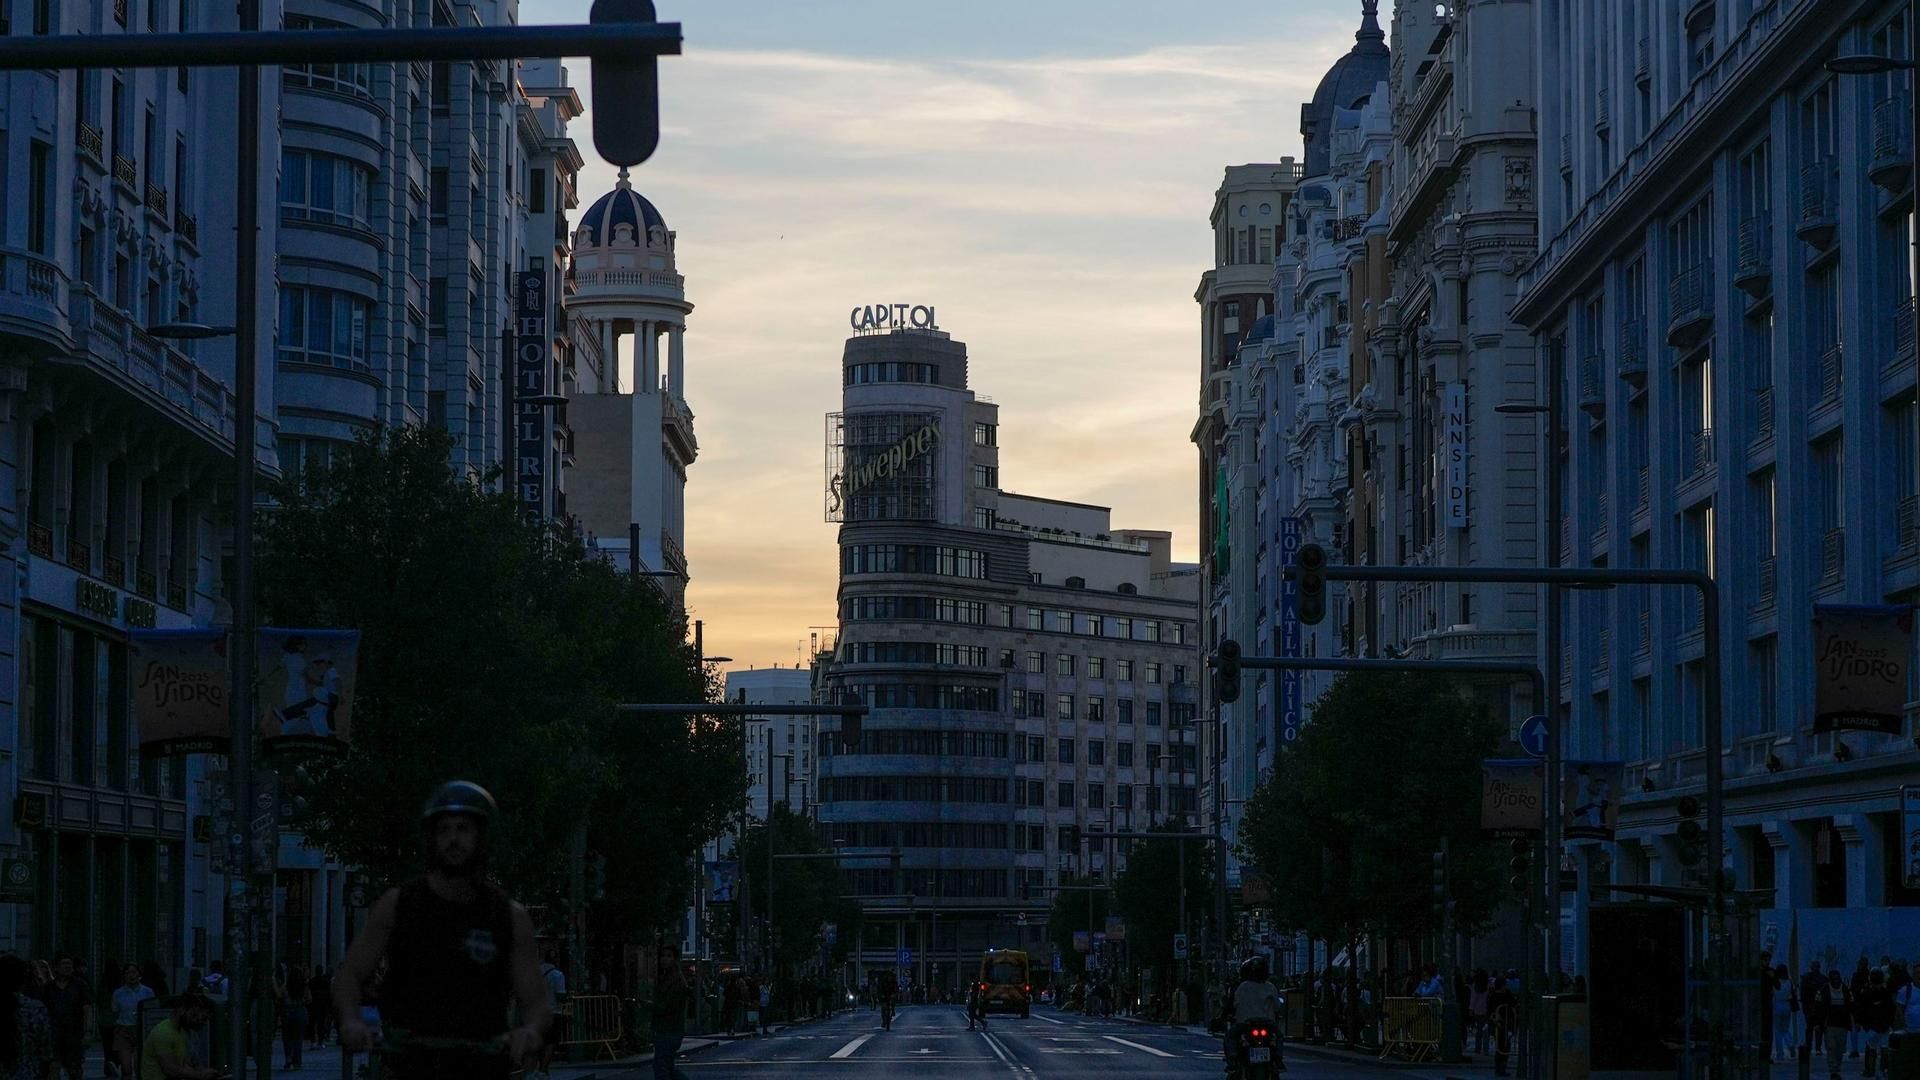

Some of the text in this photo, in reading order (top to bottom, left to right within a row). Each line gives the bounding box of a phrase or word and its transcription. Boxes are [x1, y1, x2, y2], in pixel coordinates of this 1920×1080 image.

[851, 304, 939, 329] CAPITOL
[520, 317, 544, 441] HOTEL
[830, 419, 944, 513] Schweppes
[1284, 520, 1297, 595] HOTL
[1820, 634, 1887, 662] SAN 2025
[139, 660, 209, 689] SAN 2025
[1842, 717, 1879, 727] MADRID
[176, 742, 213, 751] MADRID
[1486, 780, 1510, 796] SAN
